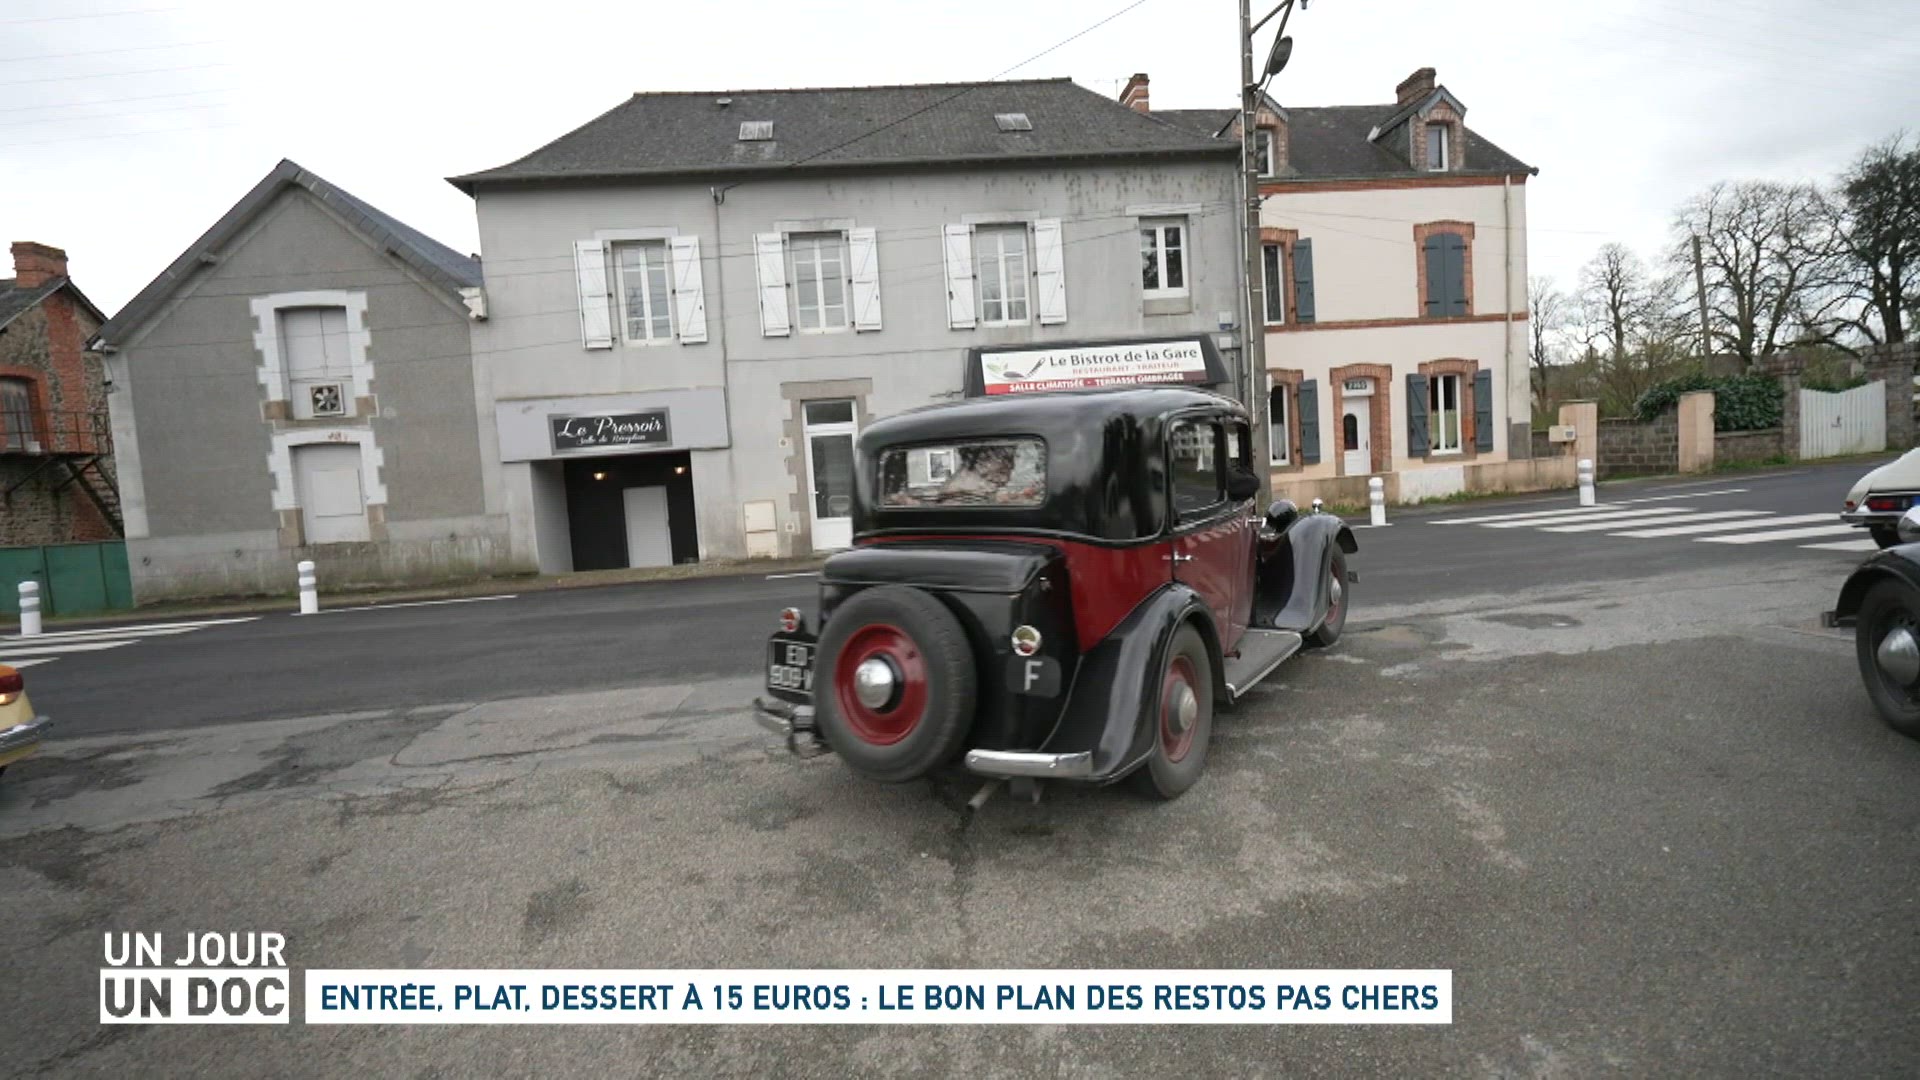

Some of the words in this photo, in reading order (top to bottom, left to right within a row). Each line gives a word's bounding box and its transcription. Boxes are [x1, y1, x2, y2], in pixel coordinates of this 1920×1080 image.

[1050, 355, 1066, 367] Le
[1070, 353, 1120, 366] Bistrot
[1124, 351, 1142, 362] de
[1145, 349, 1159, 360] la
[1163, 348, 1197, 360] Gare
[1072, 365, 1129, 375] RESTAURANT
[1137, 361, 1179, 371] TRAITEUR
[1009, 383, 1035, 393] SALLE
[1036, 379, 1084, 391] CLIMATISÉE
[1094, 375, 1136, 387] TERRASSE
[1137, 371, 1184, 383] OMBRAGÉE
[557, 417, 587, 438] Le
[594, 416, 663, 435] Pressoir
[1024, 659, 1043, 691] F
